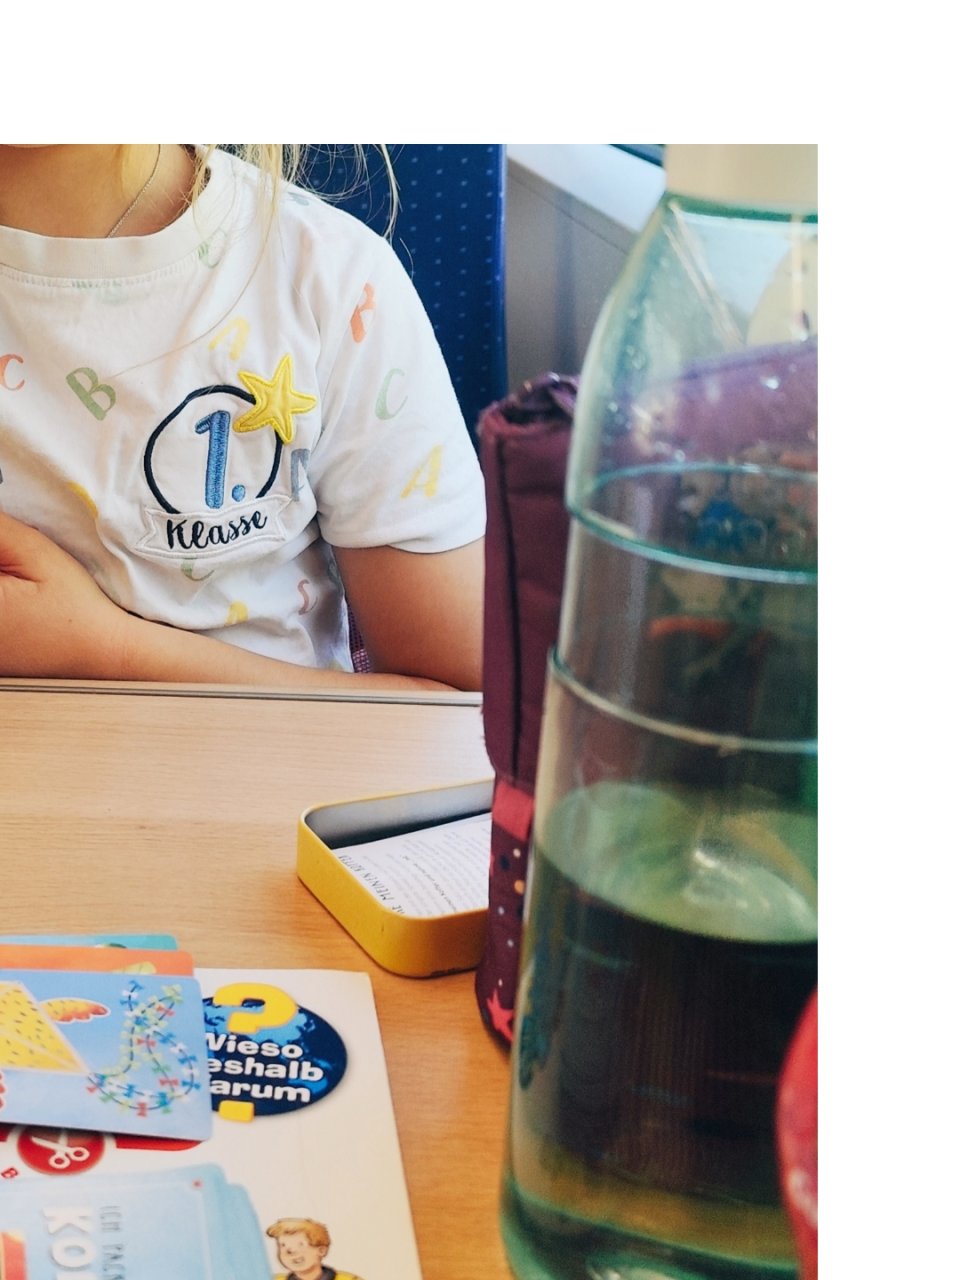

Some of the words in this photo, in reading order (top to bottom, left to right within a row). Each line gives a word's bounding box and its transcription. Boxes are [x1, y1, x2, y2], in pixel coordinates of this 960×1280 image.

[65, 367, 116, 421] B
[195, 410, 246, 509] 1.
[167, 510, 268, 550] Klasse
[208, 1057, 324, 1082] eshalb
[210, 1079, 311, 1103] arum
[100, 1205, 123, 1232] ICH
